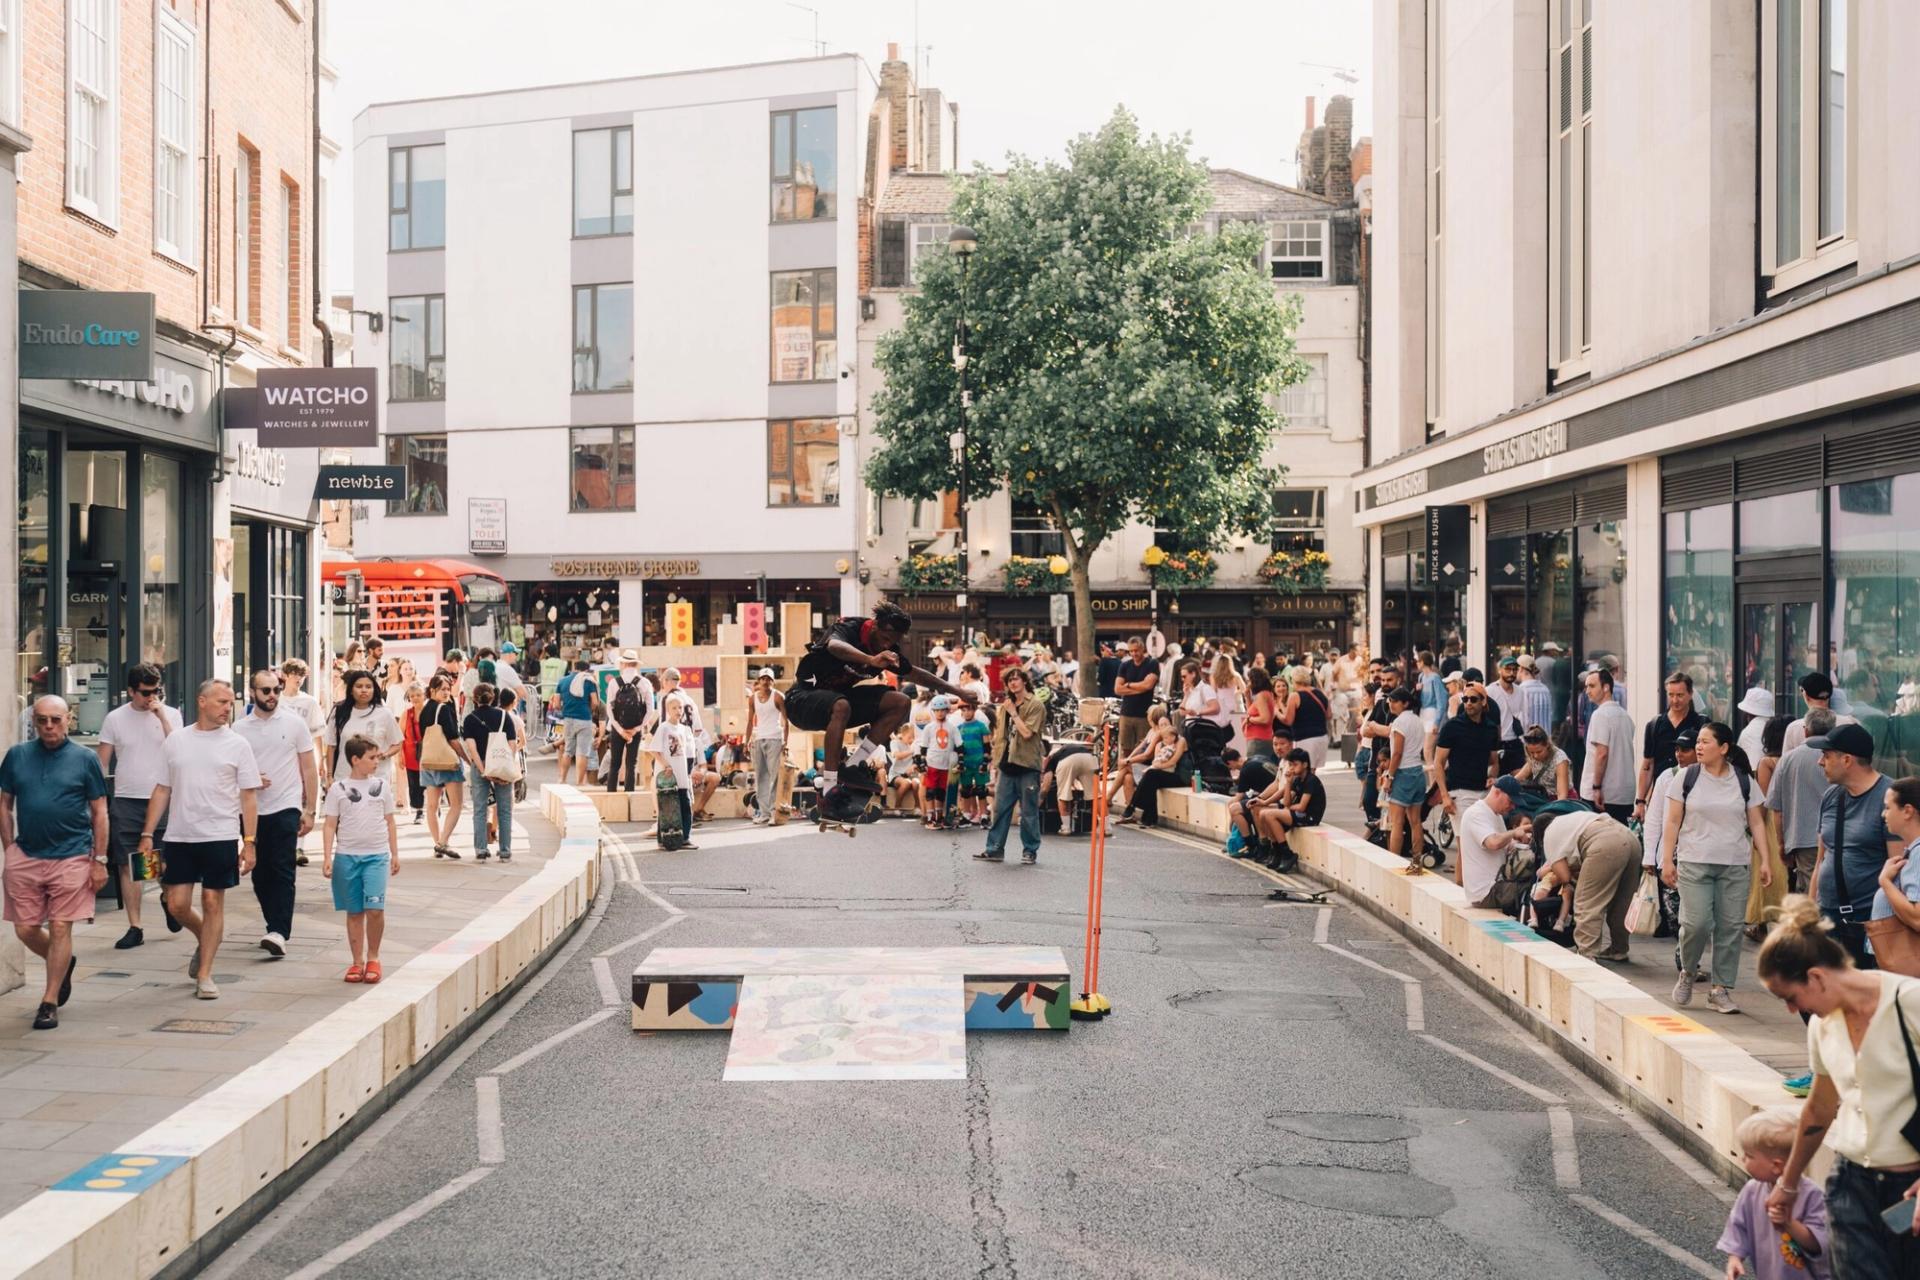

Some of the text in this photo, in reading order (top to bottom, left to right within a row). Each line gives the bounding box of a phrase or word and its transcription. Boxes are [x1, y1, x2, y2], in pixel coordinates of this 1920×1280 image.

[24, 323, 140, 346] EndoCare
[794, 342, 812, 352] LET
[264, 386, 369, 405] WATCHO
[264, 420, 370, 429] WATCHES & JEWELLERY
[328, 474, 394, 489] newbie
[1431, 508, 1439, 536] SUSHI
[475, 530, 501, 538] TO LET
[553, 559, 700, 580] SØSTRENE GRENE
[1431, 548, 1439, 582] STICKS
[70, 592, 128, 603] GARMN
[1091, 599, 1149, 611] OLD SHIP
[1264, 596, 1342, 611] Saloon
